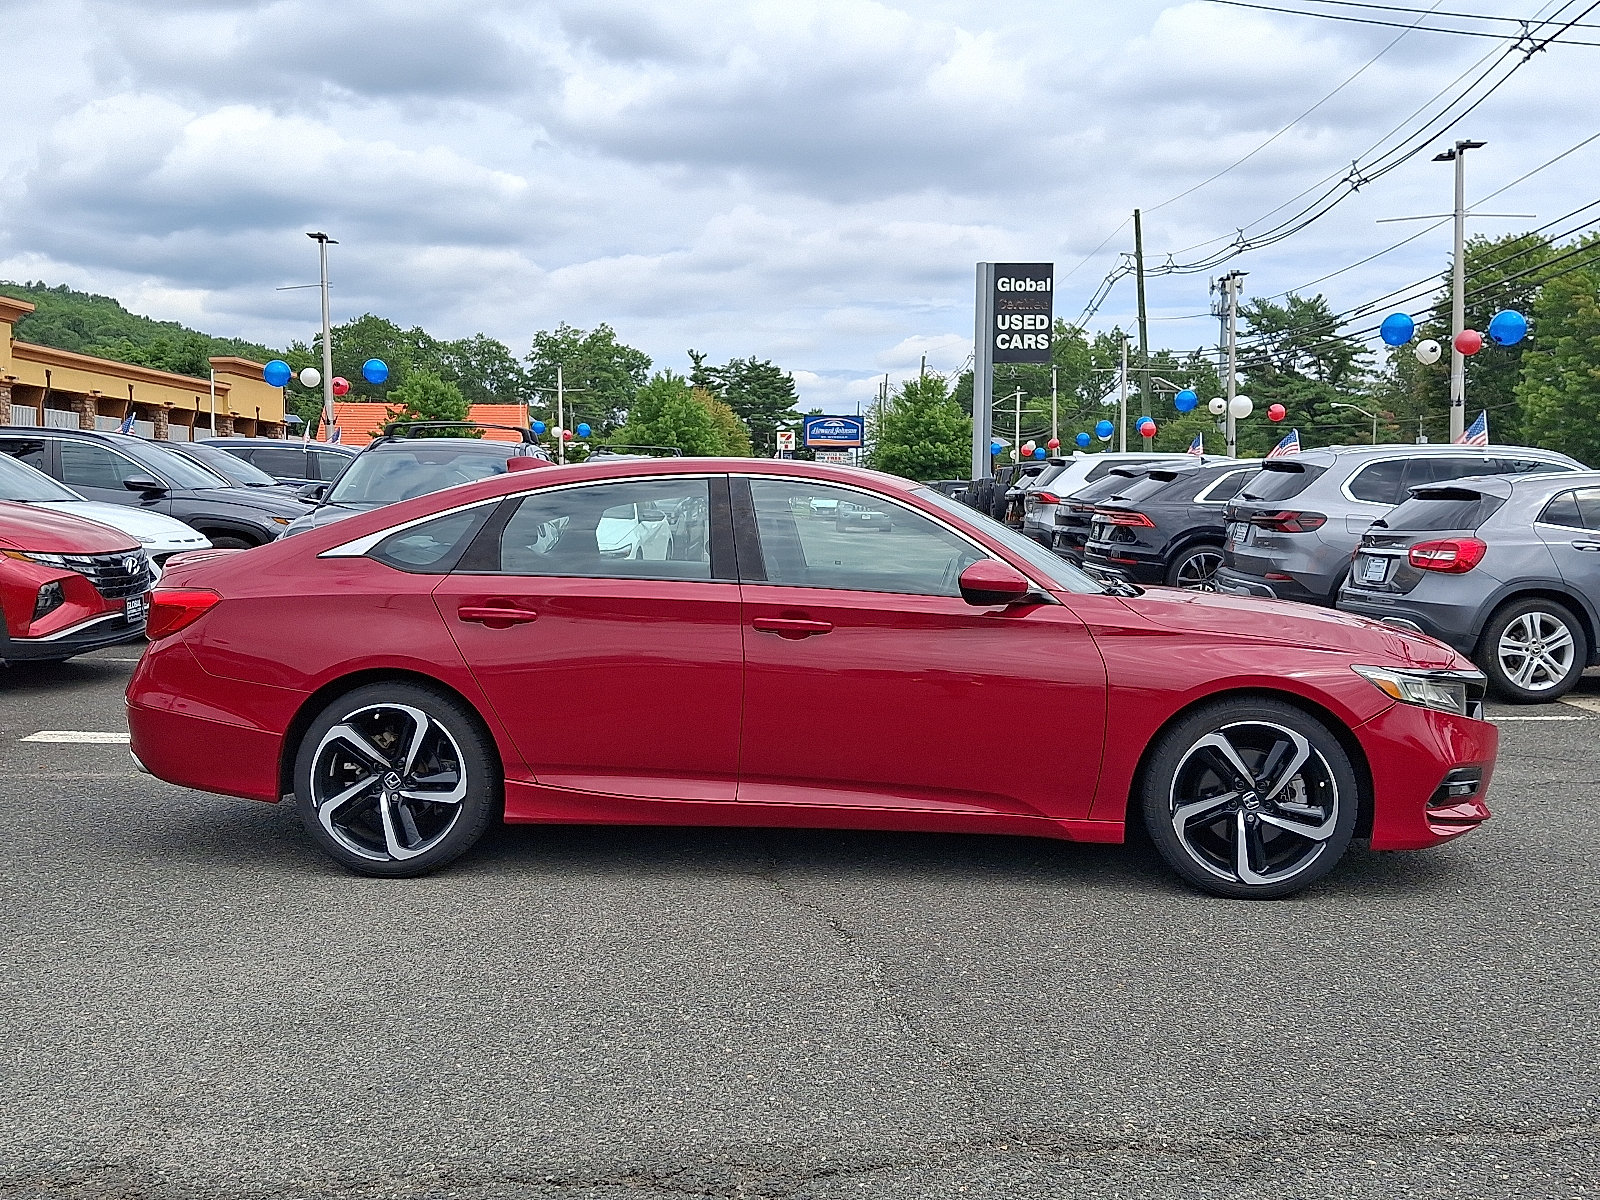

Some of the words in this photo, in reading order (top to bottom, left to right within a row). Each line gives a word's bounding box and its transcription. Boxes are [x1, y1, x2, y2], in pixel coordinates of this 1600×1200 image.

[997, 277, 1051, 292] Global
[997, 314, 1049, 330] USED
[996, 333, 1049, 350] CARS
[811, 427, 835, 435] Howard
[834, 426, 857, 436] Johnson
